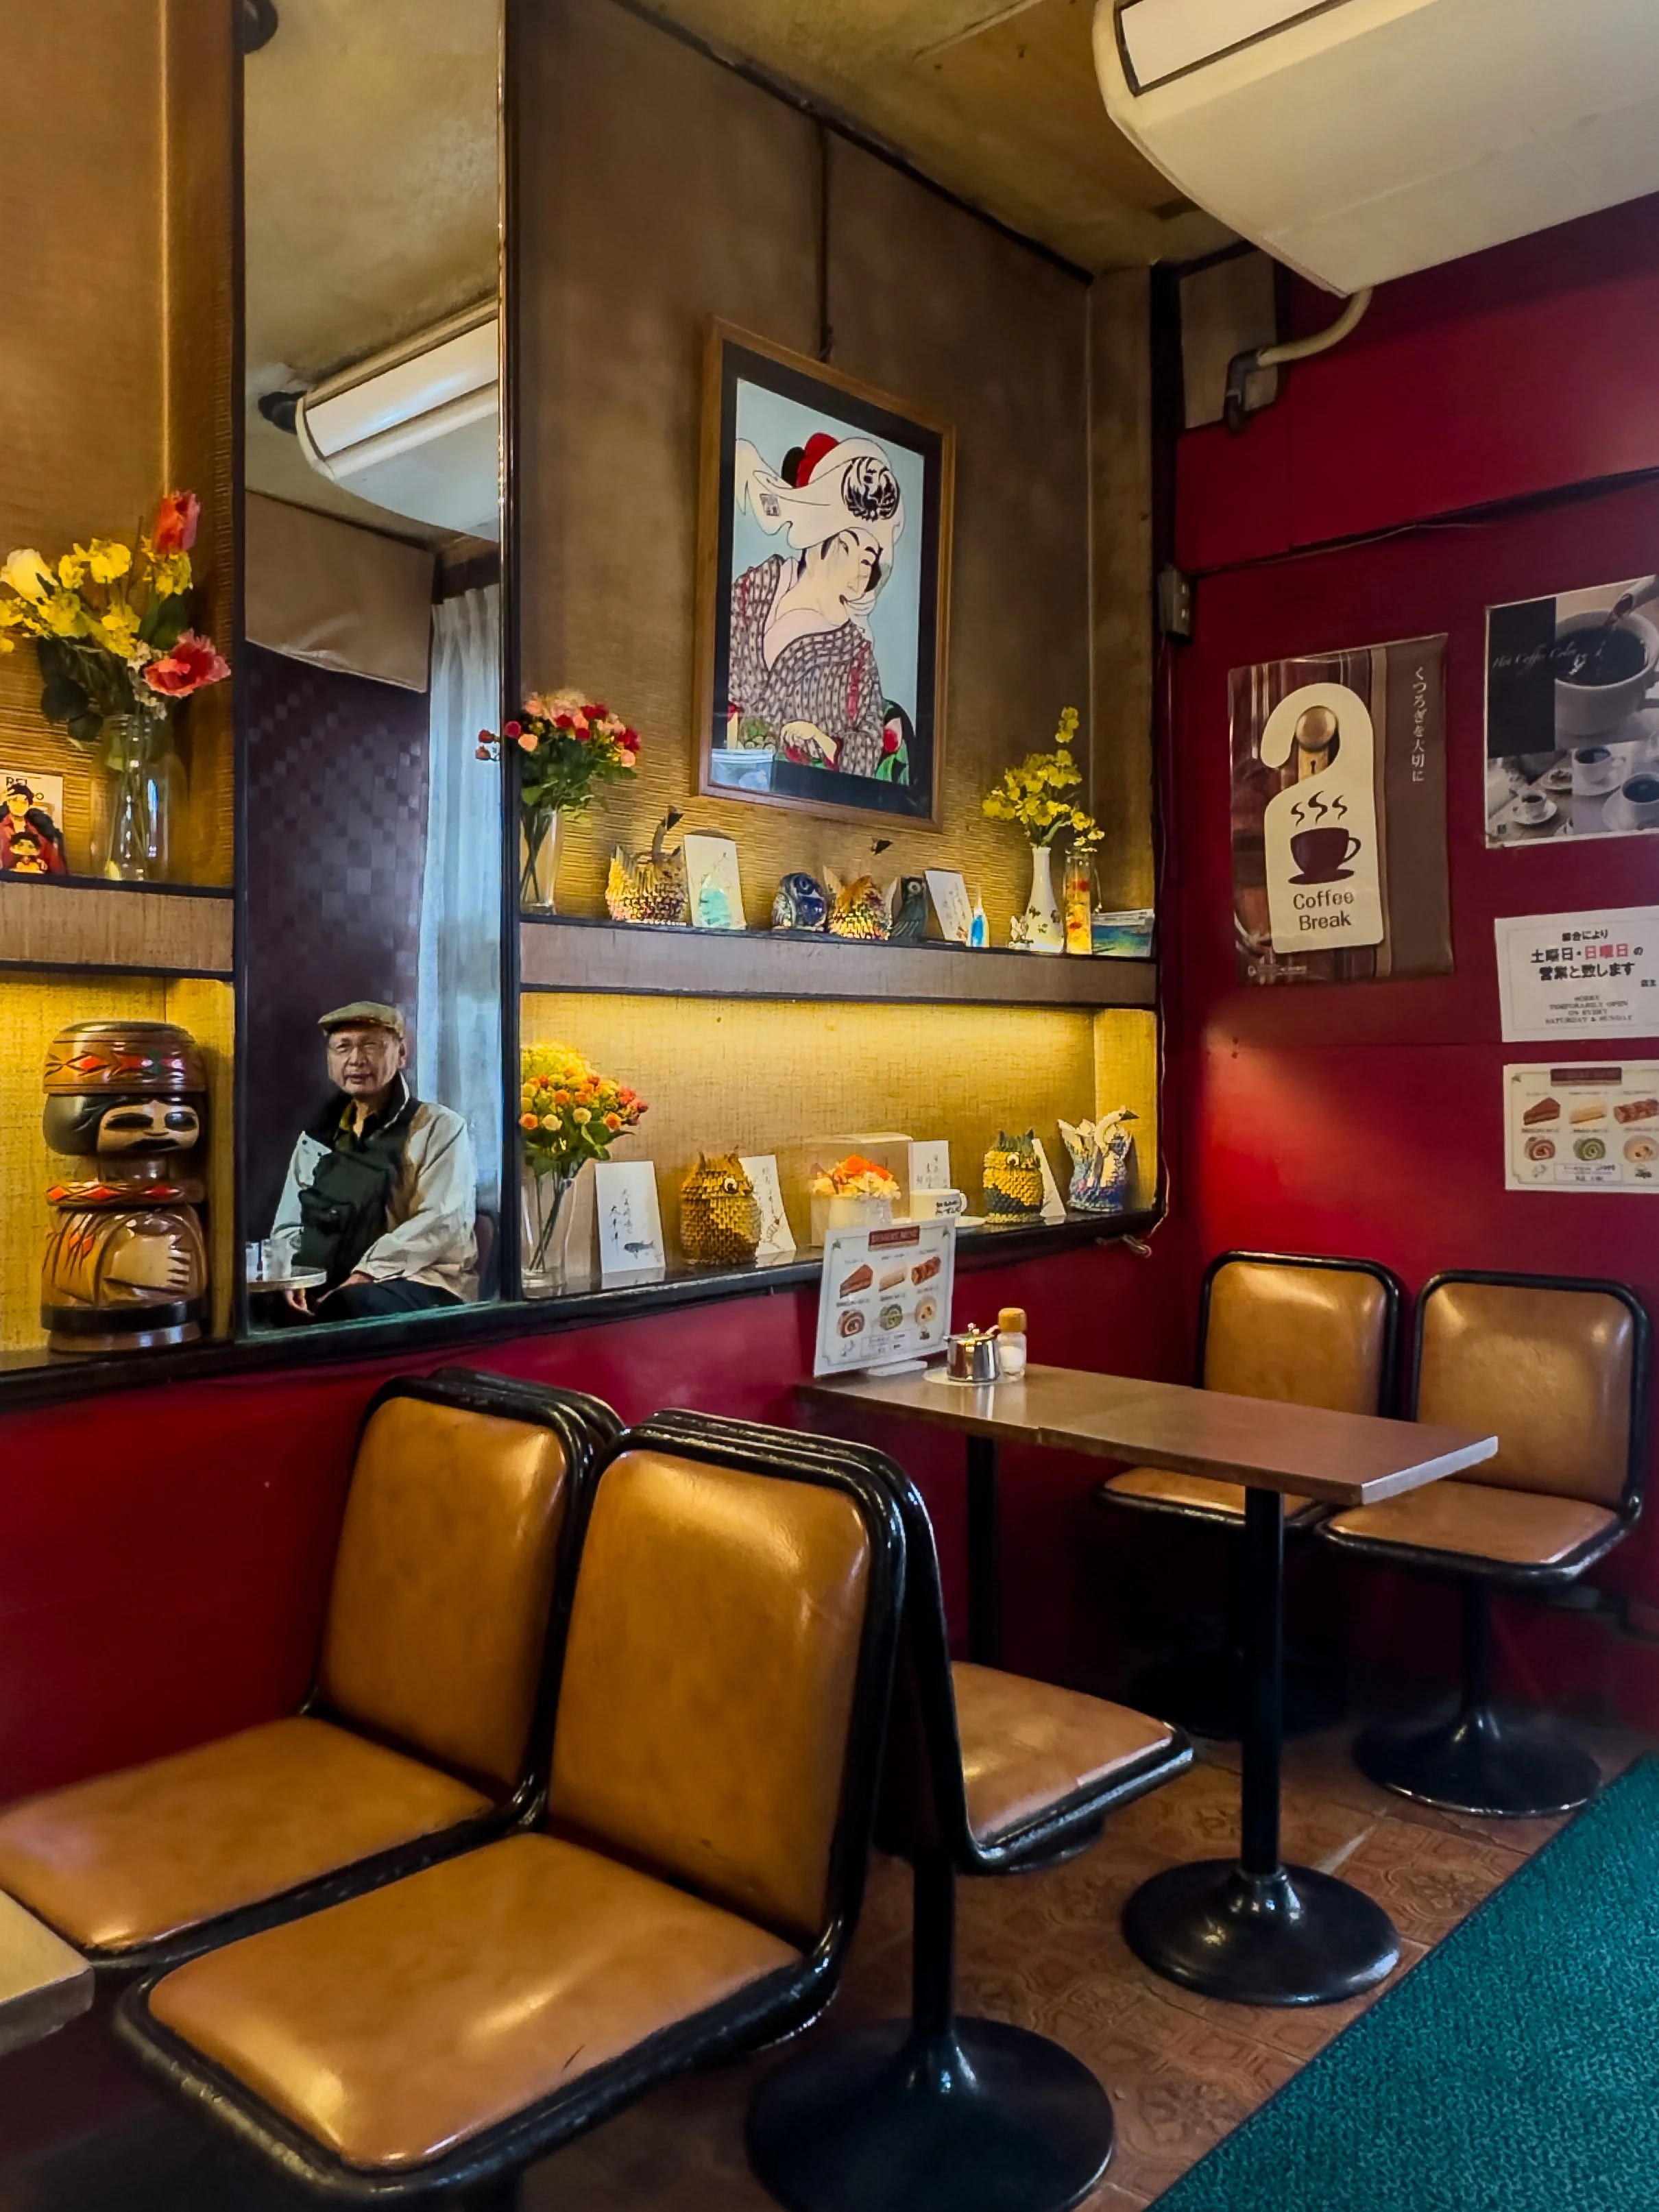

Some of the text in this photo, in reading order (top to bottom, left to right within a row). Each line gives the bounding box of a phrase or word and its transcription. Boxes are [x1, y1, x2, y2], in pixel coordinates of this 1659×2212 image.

[1412, 666, 1427, 782] くつろぎを大切に
[1293, 889, 1354, 911] Coffee
[1298, 910, 1351, 931] Break
